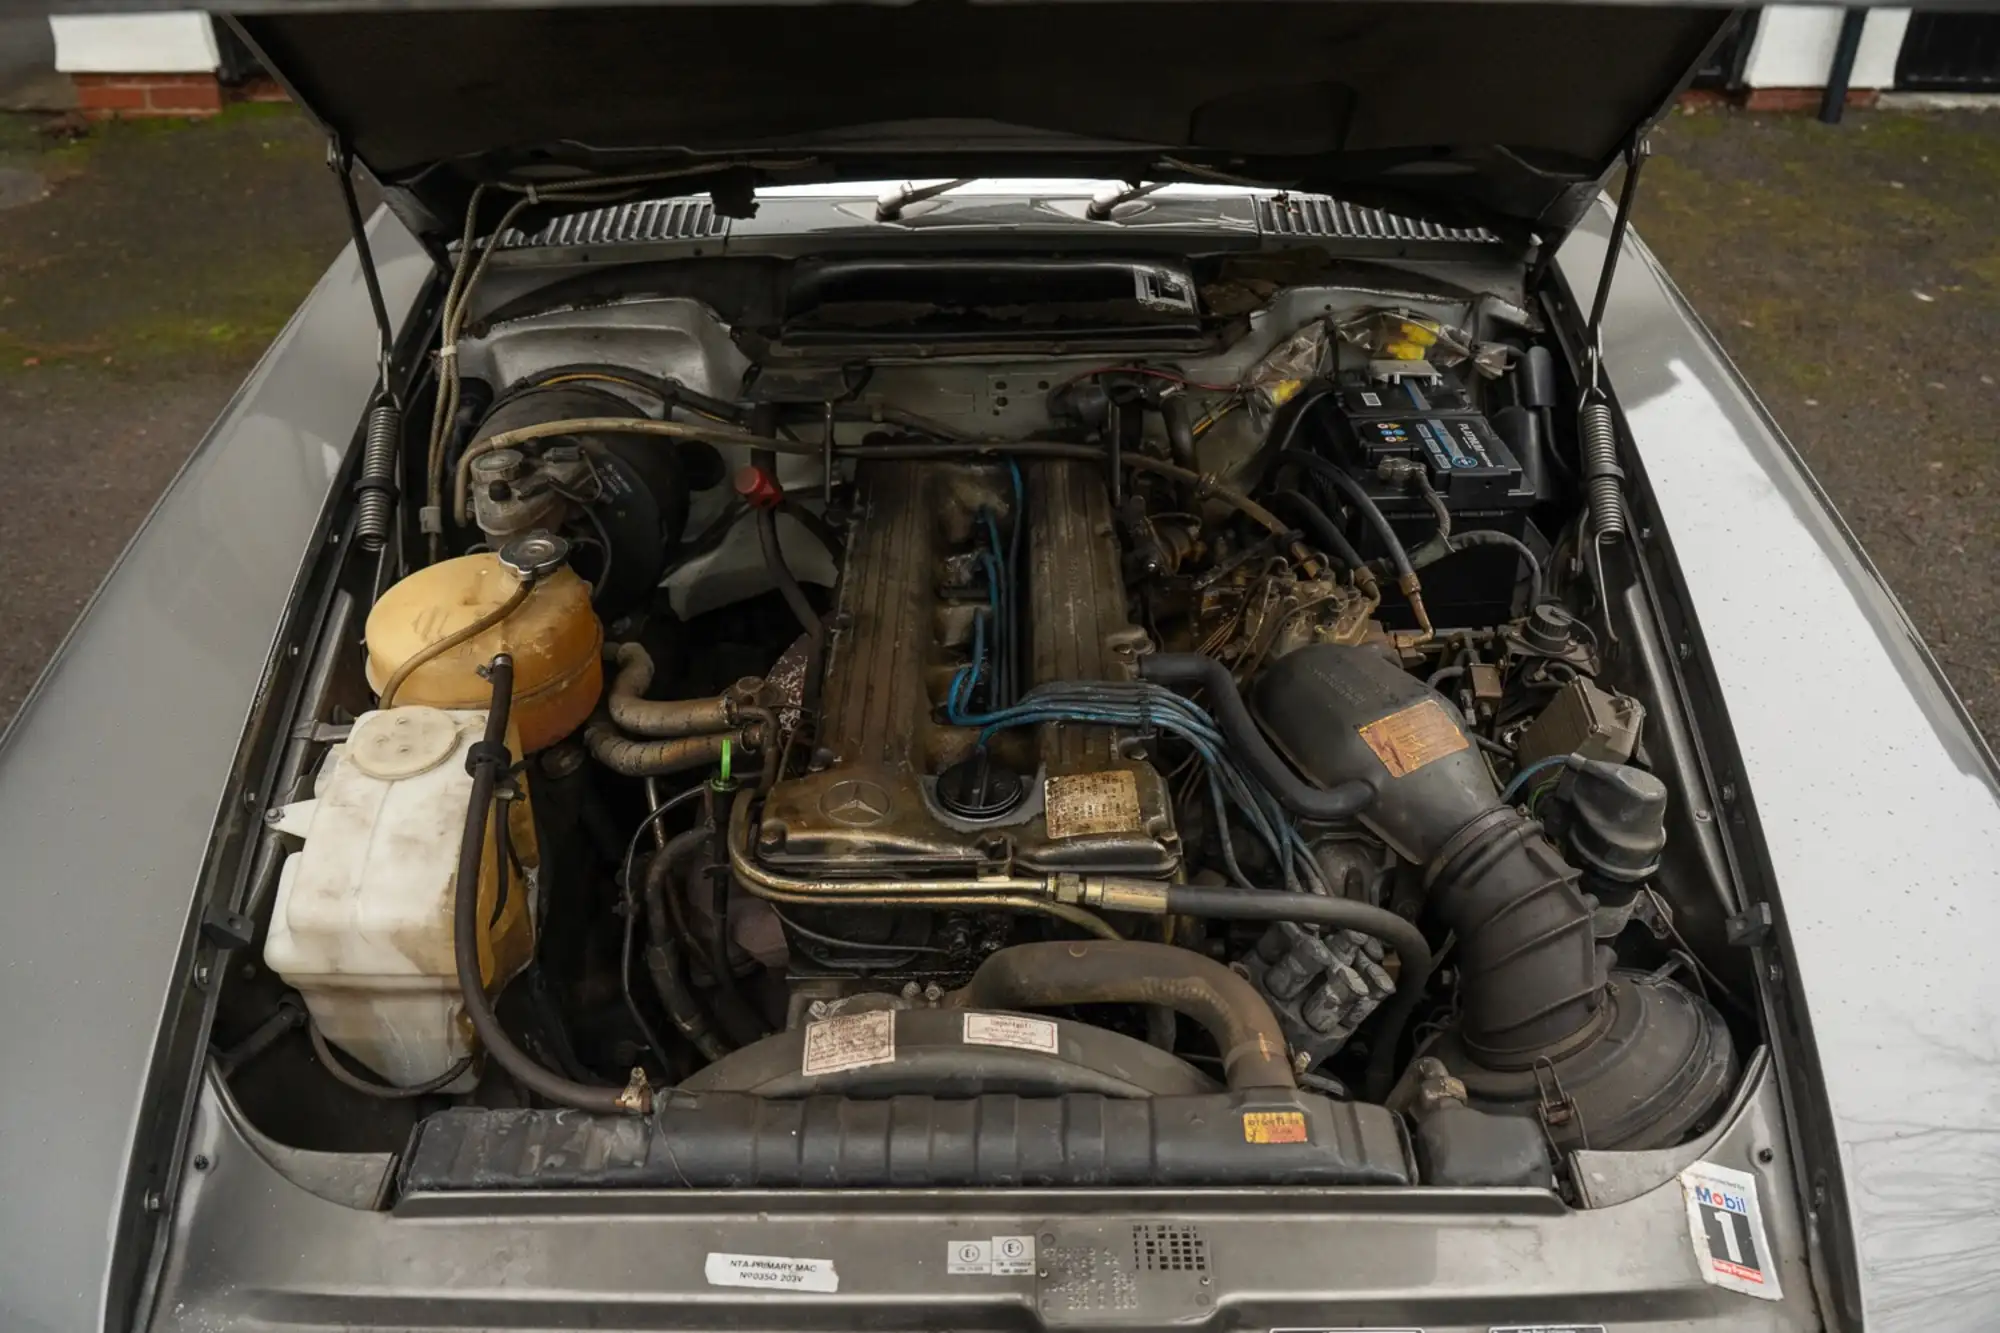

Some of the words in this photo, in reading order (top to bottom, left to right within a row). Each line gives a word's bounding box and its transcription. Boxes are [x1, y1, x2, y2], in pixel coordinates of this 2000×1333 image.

[1457, 423, 1486, 452] PLATINUM
[1694, 1184, 1746, 1213] Mobil
[1713, 1211, 1743, 1263] 1
[795, 1264, 817, 1273] MAC
